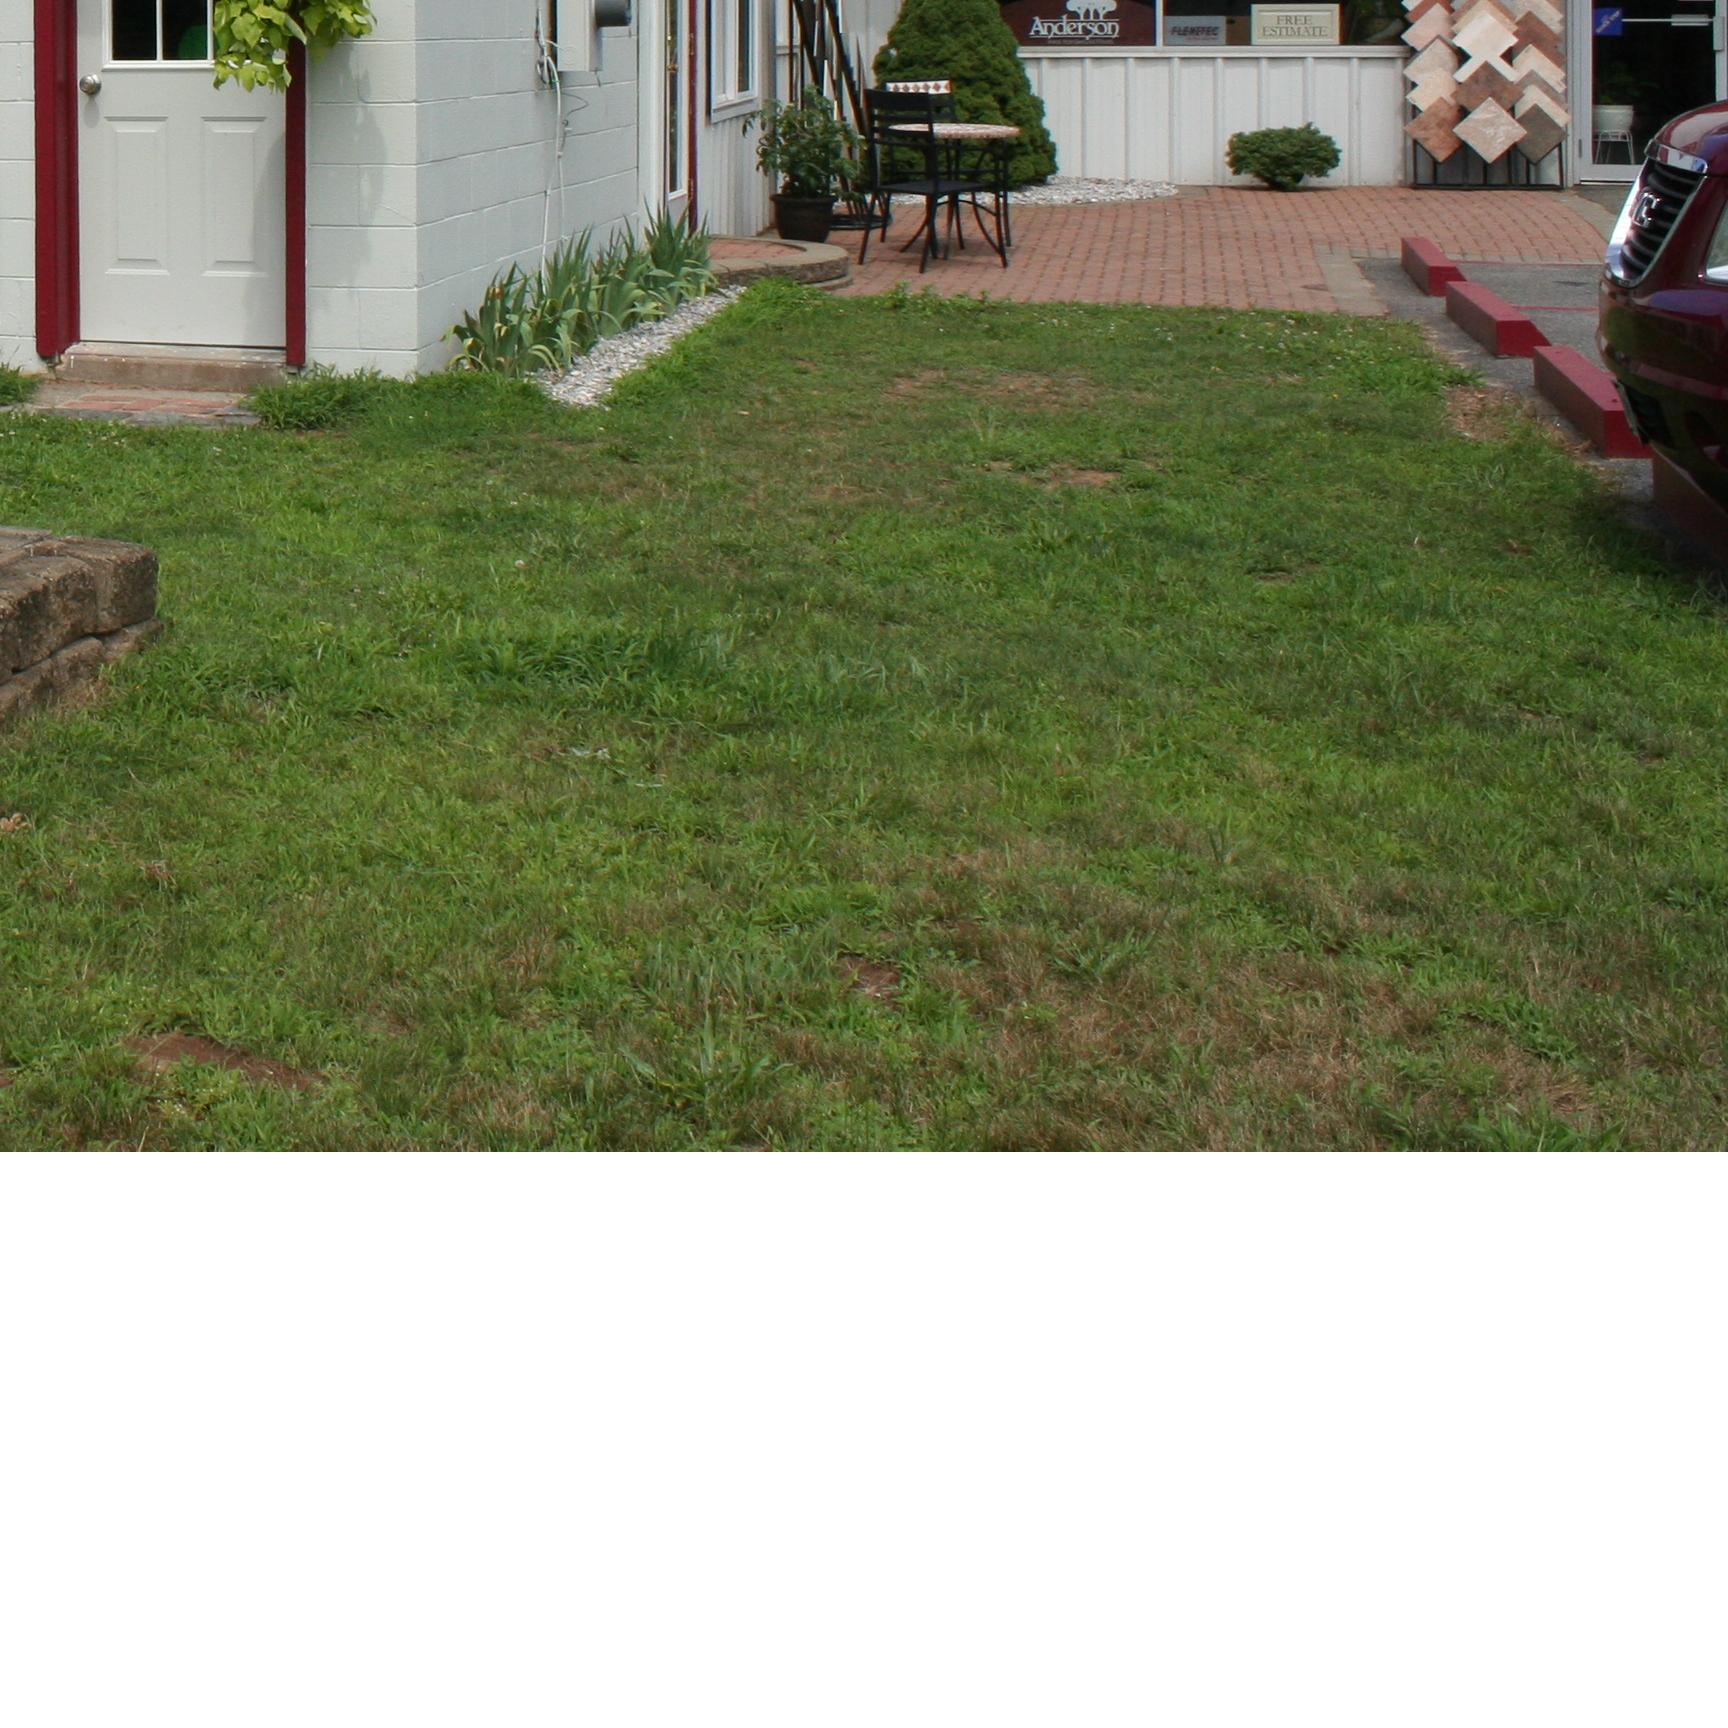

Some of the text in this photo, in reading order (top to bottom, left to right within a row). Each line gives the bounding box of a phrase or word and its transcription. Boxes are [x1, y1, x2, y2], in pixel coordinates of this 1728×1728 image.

[1276, 15, 1313, 25] FREE
[1029, 14, 1119, 40] Anderson
[1262, 26, 1328, 37] ESTIMATE
